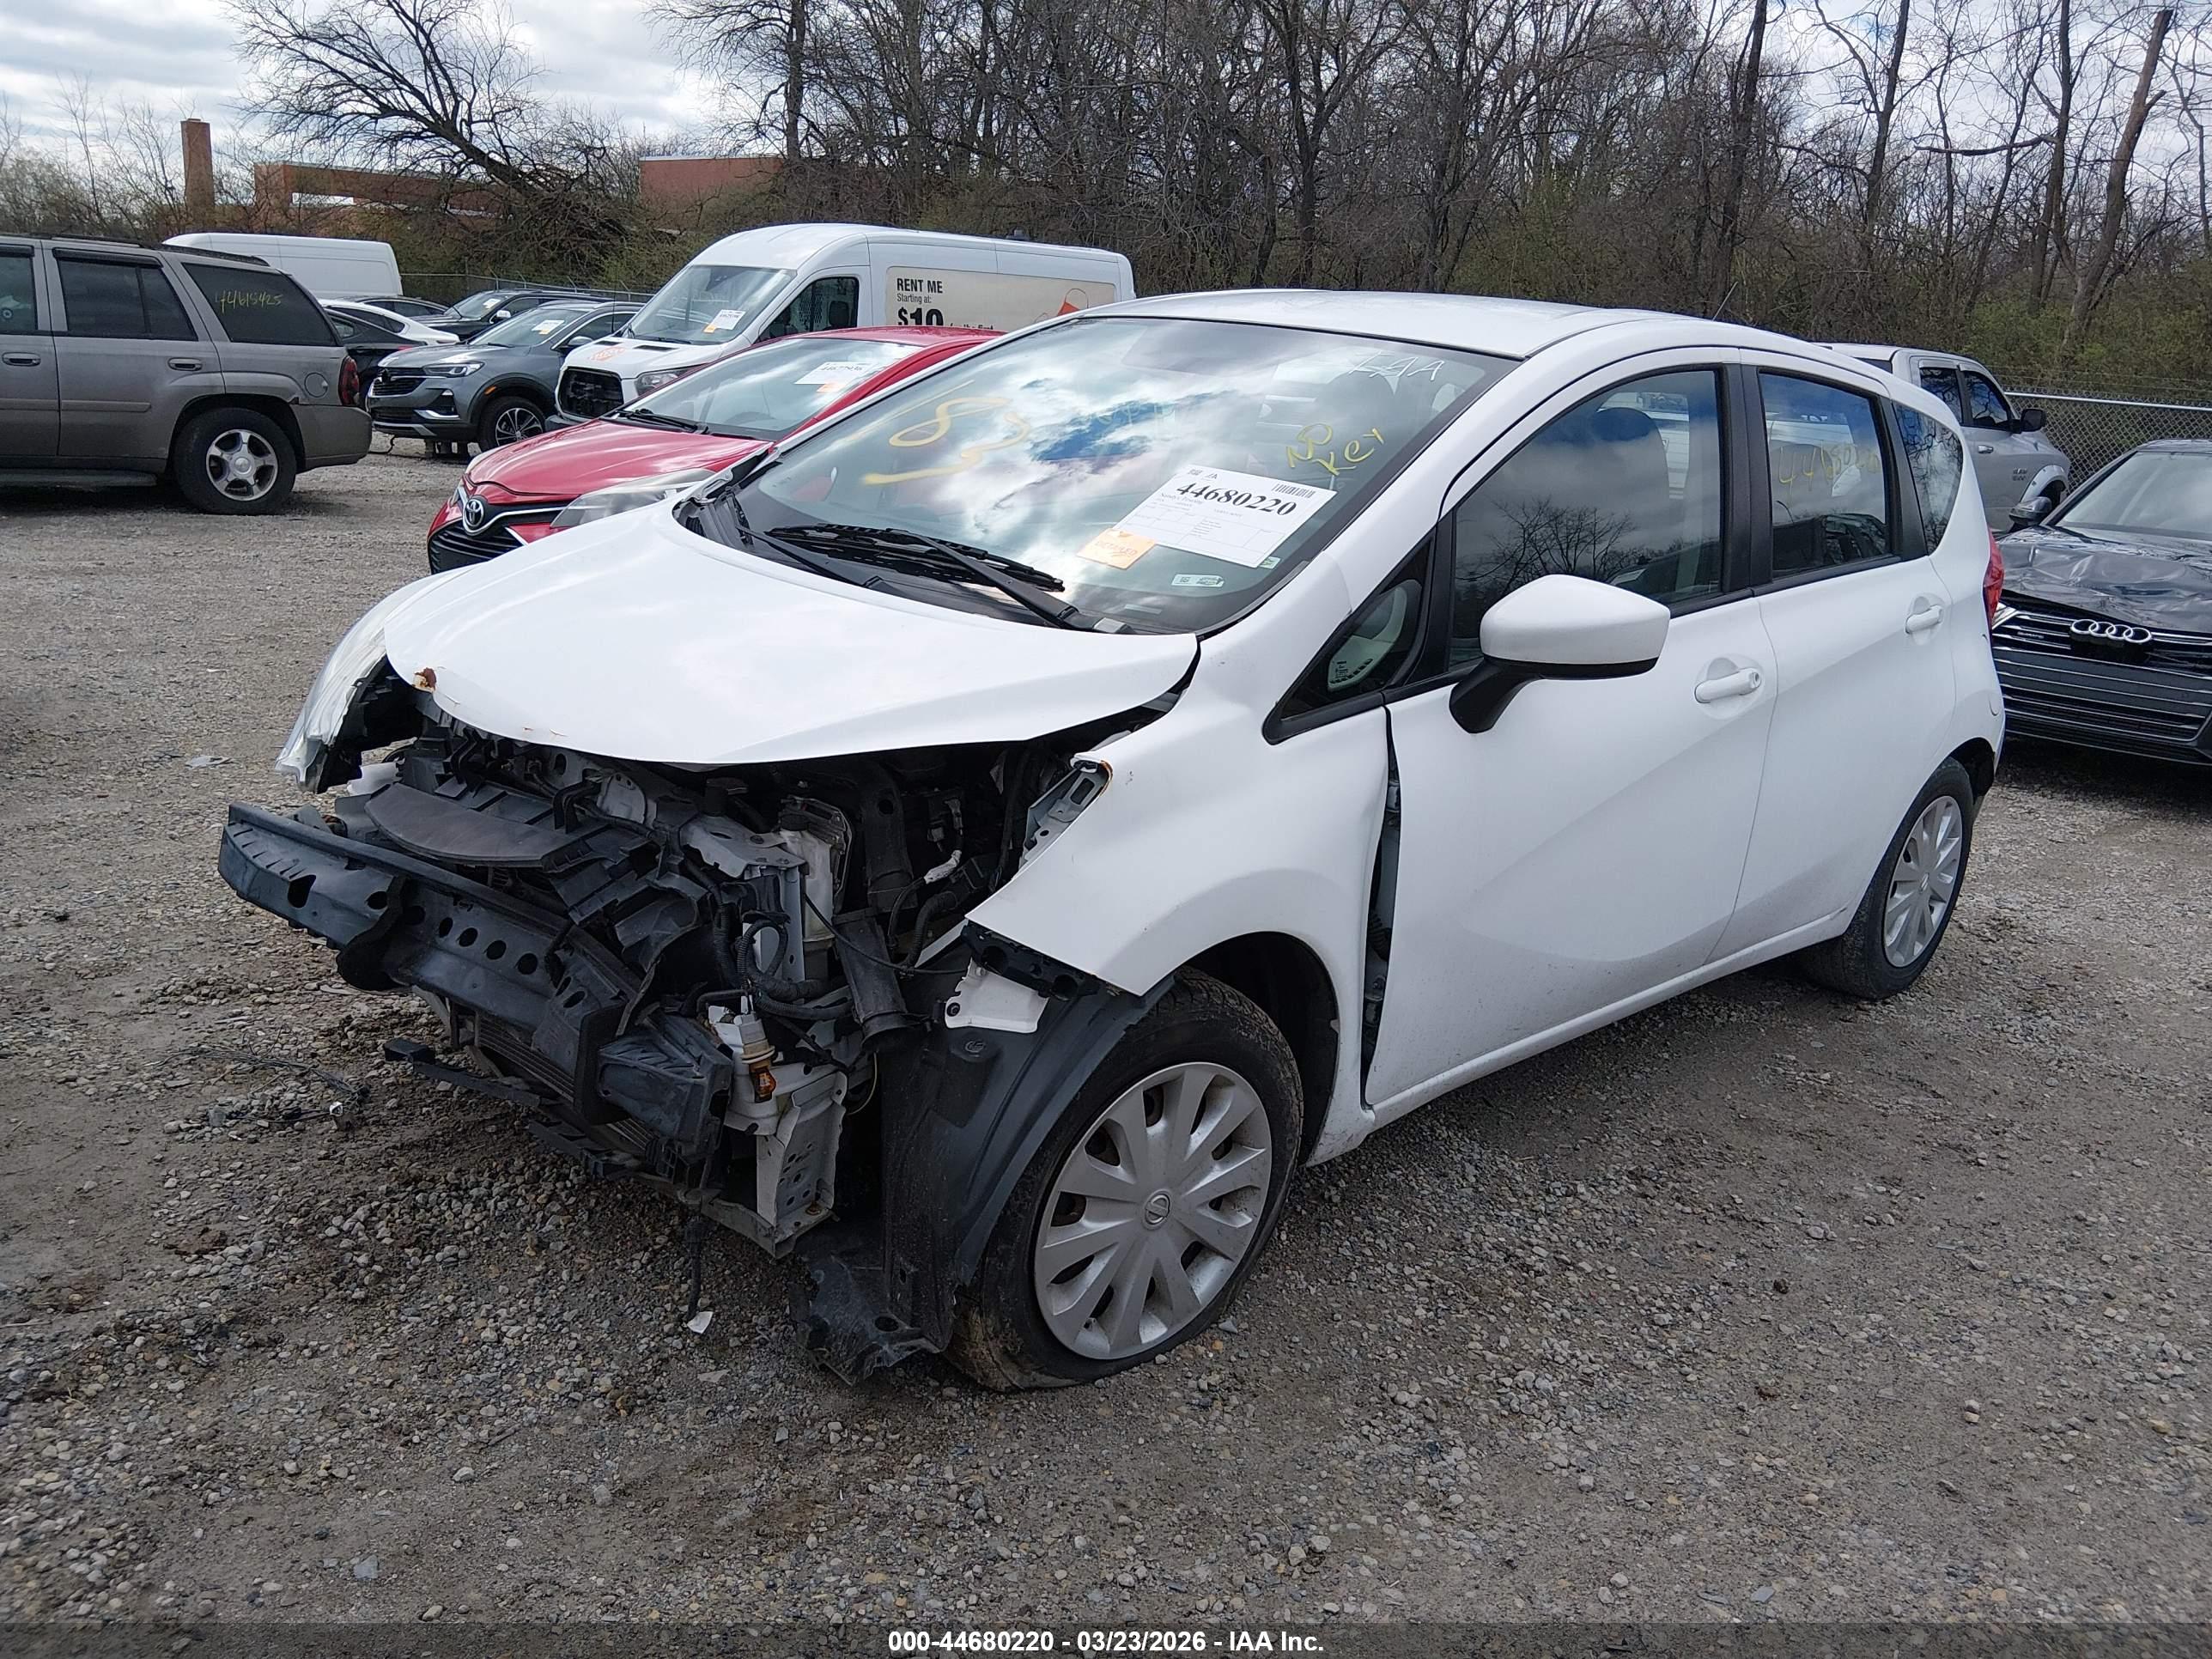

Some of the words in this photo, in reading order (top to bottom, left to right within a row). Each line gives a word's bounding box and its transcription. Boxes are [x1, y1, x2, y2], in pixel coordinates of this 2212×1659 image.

[896, 277, 924, 292] RENT
[927, 281, 944, 294] ME
[896, 293, 922, 305] Starting
[1176, 483, 1297, 515] 44680220
